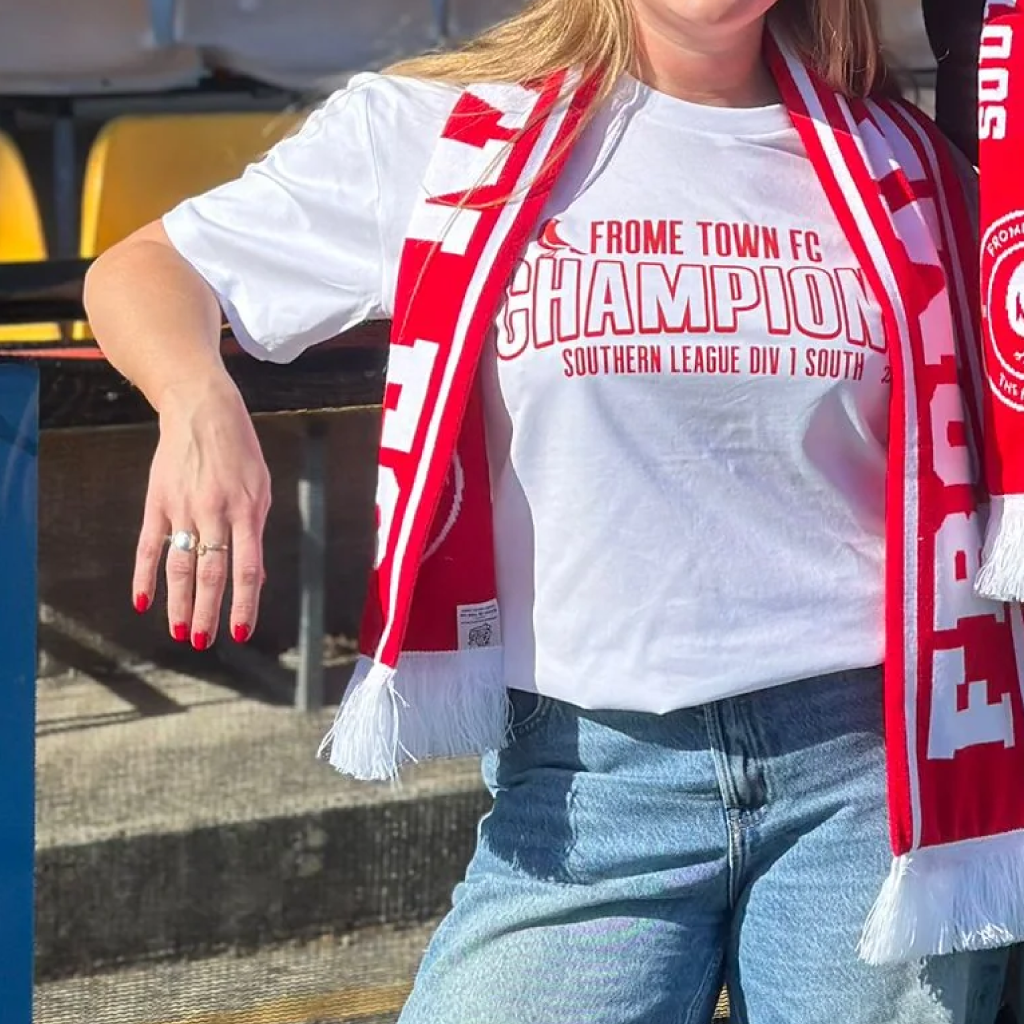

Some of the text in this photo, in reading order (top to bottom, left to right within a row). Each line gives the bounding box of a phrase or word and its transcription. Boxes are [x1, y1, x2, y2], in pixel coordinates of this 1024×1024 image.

[591, 221, 823, 263] FROME TOWN FC
[496, 258, 887, 360] CHAMPION
[562, 345, 661, 377] SOUTHERN
[671, 346, 740, 376] LEAGUE
[750, 346, 781, 375] DIV
[805, 349, 864, 380] SOUTH
[999, 373, 1018, 396] THE
